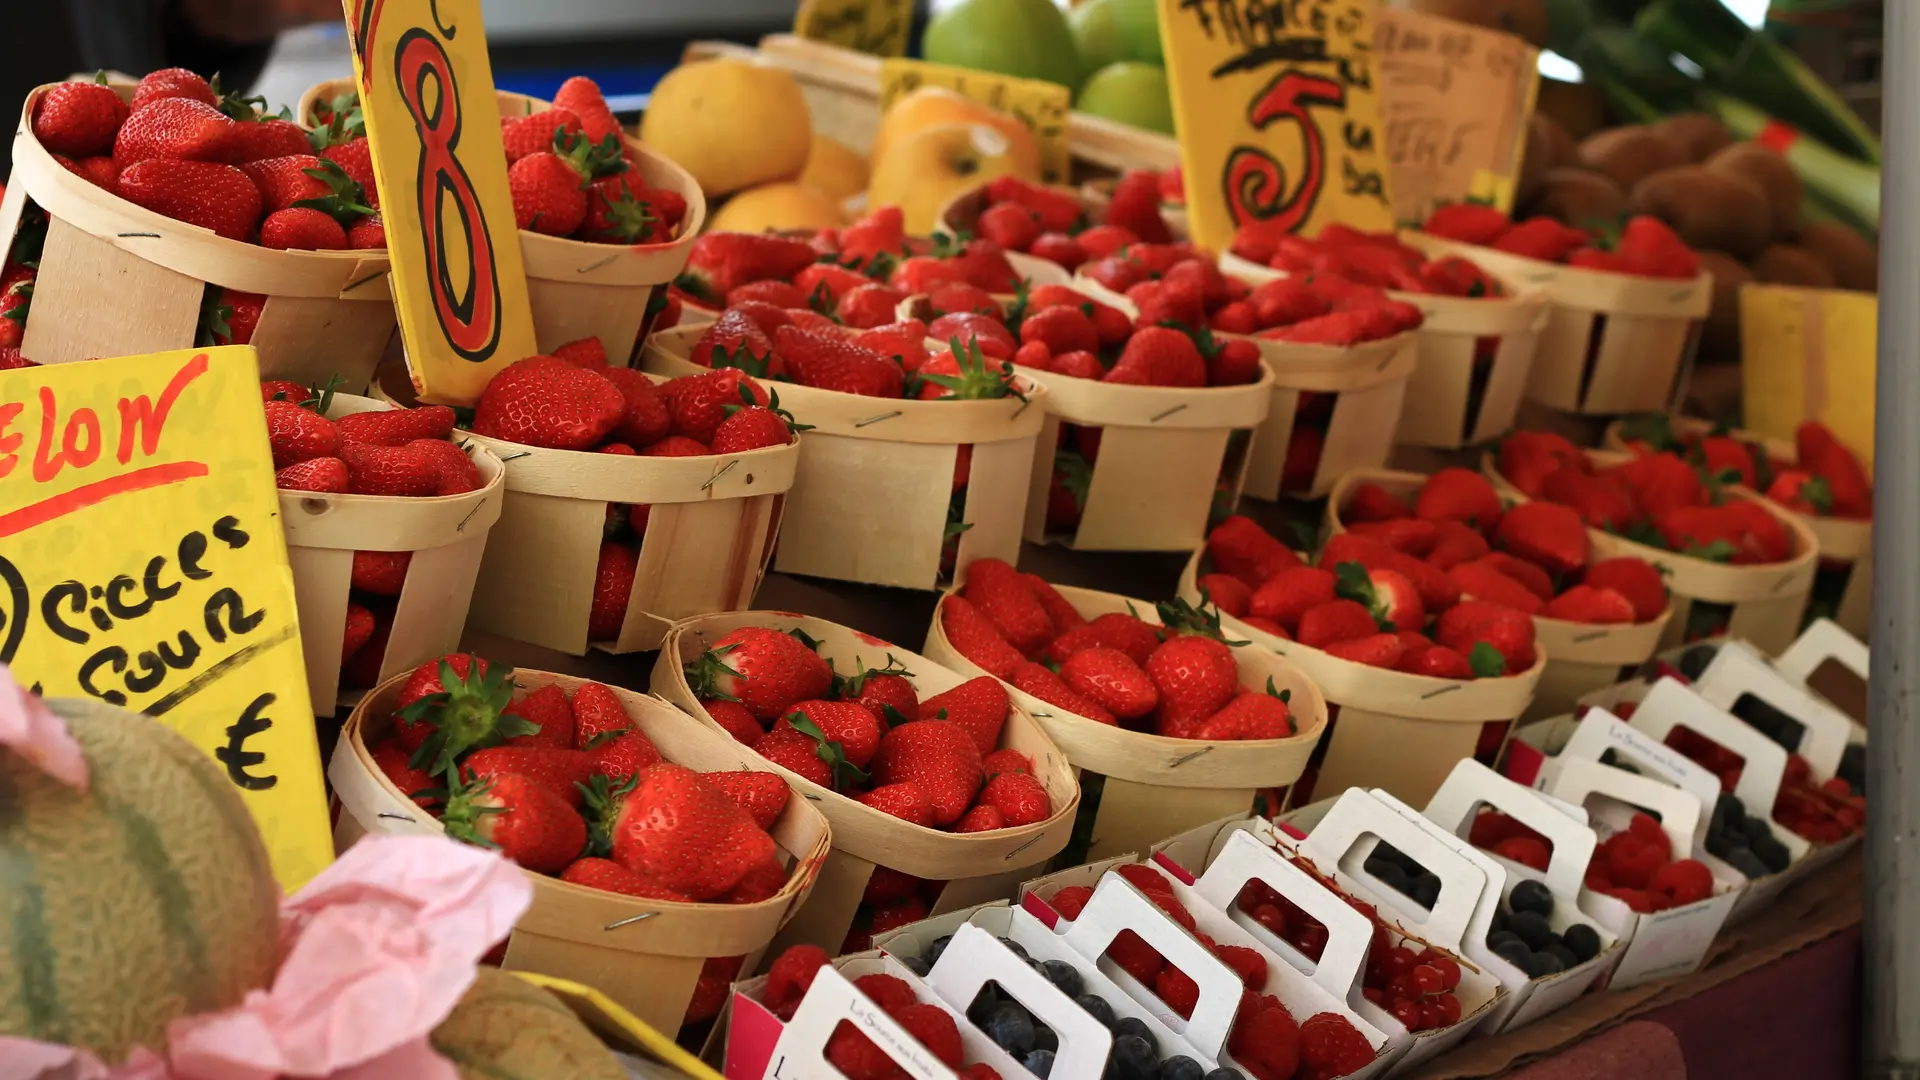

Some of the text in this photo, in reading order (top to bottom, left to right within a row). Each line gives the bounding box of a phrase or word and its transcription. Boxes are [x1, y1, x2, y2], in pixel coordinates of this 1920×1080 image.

[394, 27, 501, 362] 8
[1221, 66, 1347, 240] 5
[216, 692, 277, 790] €
